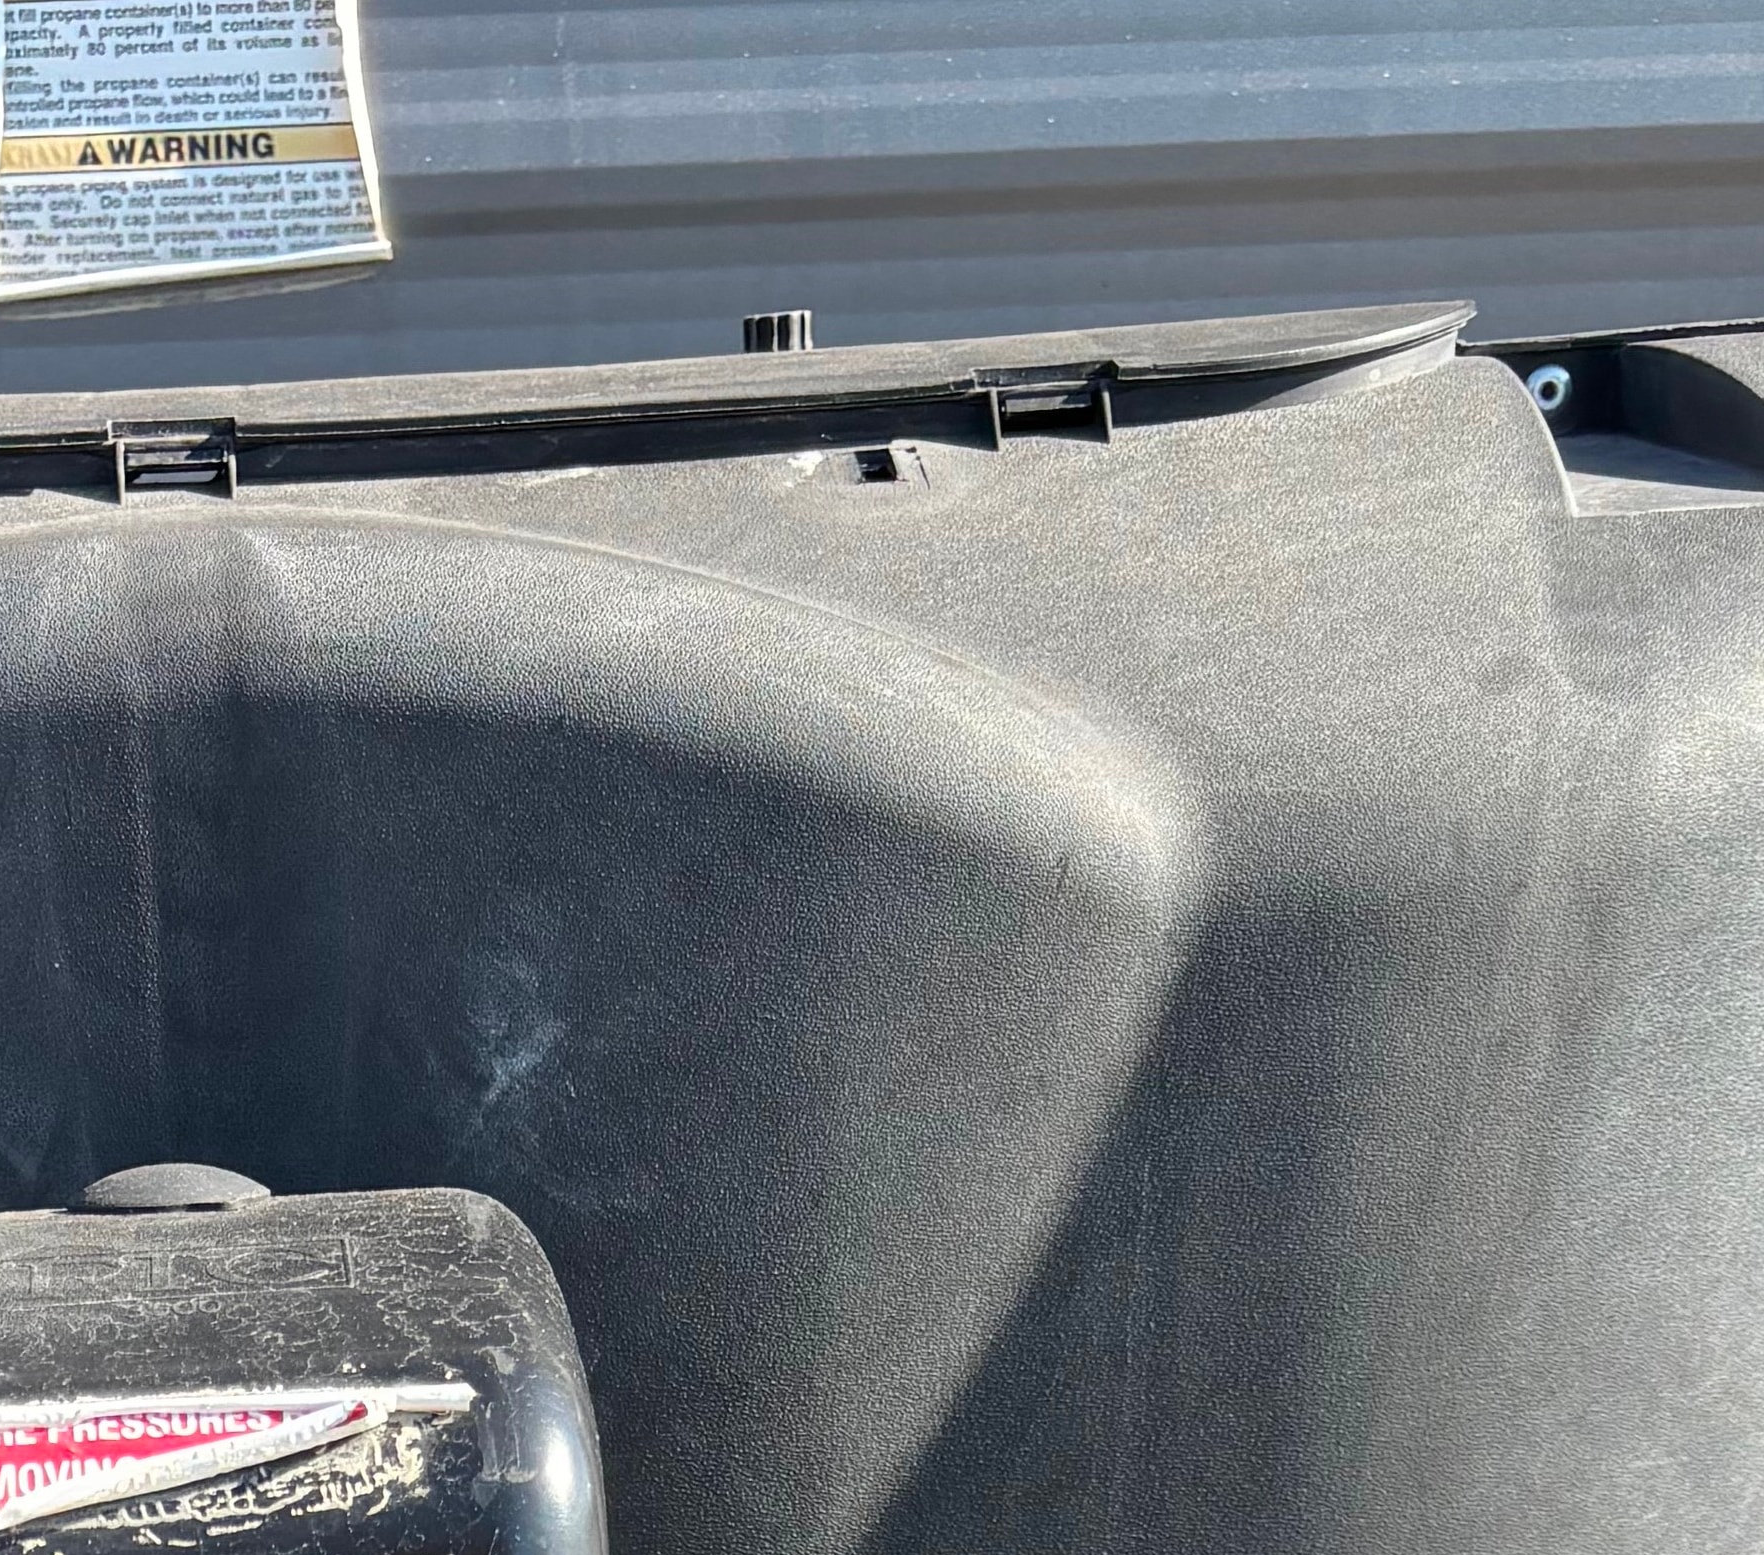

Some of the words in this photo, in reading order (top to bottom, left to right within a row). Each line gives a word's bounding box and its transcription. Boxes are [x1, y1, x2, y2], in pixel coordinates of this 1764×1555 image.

[41, 8, 101, 25] propane
[105, 2, 193, 19] container(s)
[197, 2, 212, 15] to
[216, 3, 254, 15] more
[257, 0, 290, 13] than
[78, 24, 90, 39] A
[98, 21, 164, 41] properly
[173, 19, 213, 34] filled
[221, 17, 295, 32] container
[114, 41, 174, 58] percent
[182, 38, 199, 52] of
[207, 37, 227, 51] its
[236, 36, 293, 50] volume
[301, 36, 320, 48] as
[60, 79, 85, 93] the
[93, 77, 158, 93] propane
[166, 70, 260, 88] container(s)
[268, 71, 297, 84] can
[68, 96, 129, 113] propane
[132, 94, 168, 108] flow,
[170, 91, 215, 105] which
[218, 88, 260, 104] could
[263, 87, 295, 102] lead
[298, 87, 314, 100] to
[317, 89, 327, 100] a
[52, 114, 83, 128] and
[86, 111, 132, 126] result
[135, 110, 151, 124] in
[154, 109, 198, 124] death
[202, 111, 219, 121] or
[224, 106, 282, 121] serious
[108, 131, 275, 165] WARNING
[13, 184, 75, 197] propane
[80, 181, 128, 195] piping
[133, 178, 188, 192] system
[193, 175, 207, 188] is
[211, 170, 281, 188] designed
[285, 169, 307, 183] for
[313, 170, 340, 183] use
[100, 195, 123, 210] Do
[127, 194, 155, 208] not
[160, 191, 223, 207] connect
[229, 188, 285, 203] natural
[291, 189, 319, 205] gas
[325, 186, 342, 199] to
[49, 214, 117, 230] Securely
[122, 213, 151, 227] cap
[155, 210, 190, 225] inlet
[193, 210, 235, 223] when
[240, 208, 267, 221] not
[270, 203, 352, 220] connected
[24, 233, 61, 247] After
[65, 231, 124, 248] turning
[127, 232, 150, 244] on
[153, 229, 223, 245] propane,
[227, 225, 279, 240] except
[283, 223, 320, 237] after
